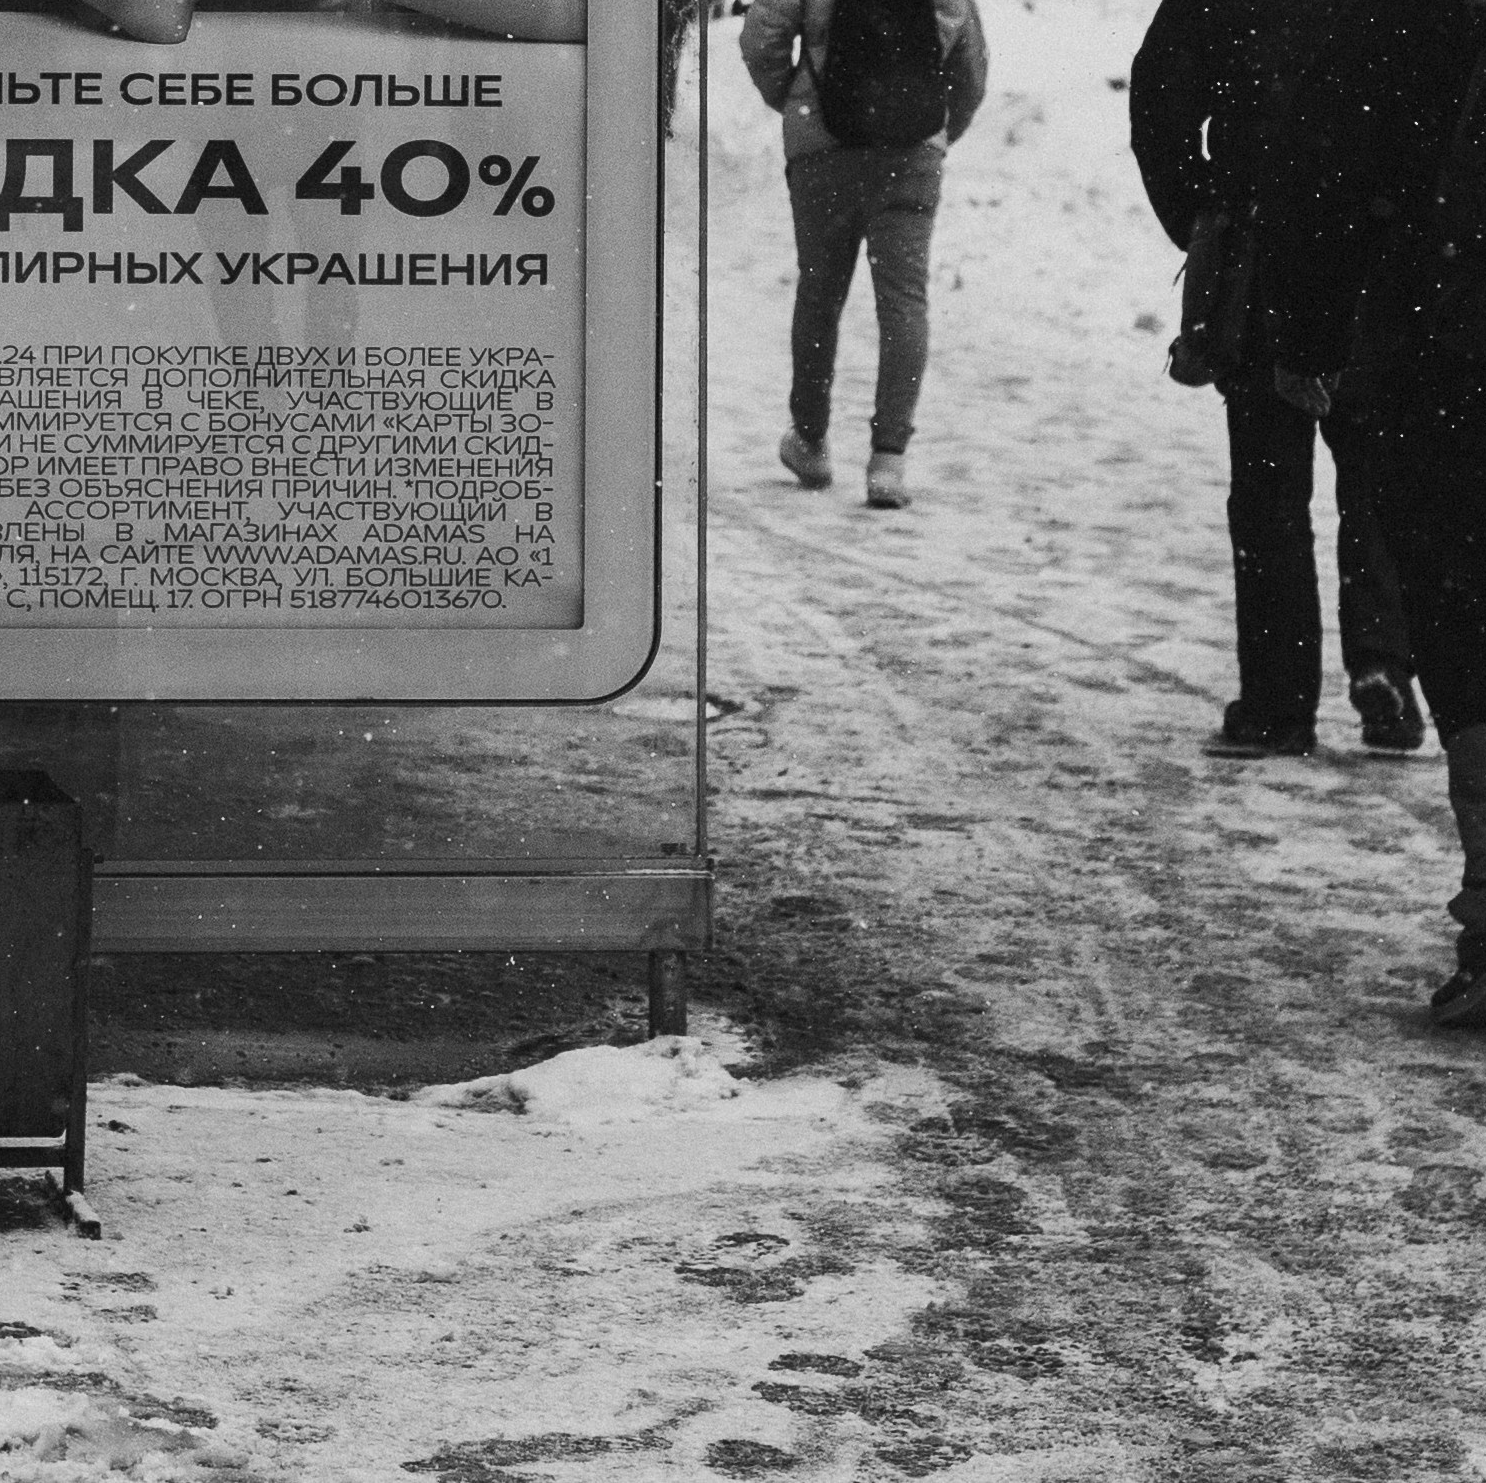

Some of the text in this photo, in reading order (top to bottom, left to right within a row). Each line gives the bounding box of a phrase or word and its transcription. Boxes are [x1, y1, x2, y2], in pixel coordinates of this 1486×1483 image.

[120, 72, 254, 107] СЕБЕ
[270, 73, 503, 108] БОЛЬШЕ
[294, 138, 556, 218] 40%
[216, 251, 550, 287] УКРАШЕНИЯ
[43, 345, 103, 365] ПРИ
[111, 345, 249, 365] ПОКУПКЕ
[254, 346, 330, 370] ДВУХ
[337, 346, 356, 366] И
[364, 346, 462, 366] БОЛЕЕ
[468, 346, 555, 366] УКРА-
[141, 368, 426, 392] ДОПОЛНИТЕЛЬНАЯ
[439, 368, 557, 393] СКИДКА
[144, 390, 164, 410] В
[186, 390, 265, 414] ЧЕКЕ,
[285, 390, 514, 415] УЧАСТВУЮЩИЕ
[535, 391, 554, 411] В
[180, 412, 201, 432] С
[208, 412, 375, 432] БОНУСАМИ
[500, 413, 554, 433] ЗО-
[19, 434, 57, 454] НЕ
[63, 434, 285, 454] СУММИРУЕТСЯ
[291, 434, 312, 454] С
[316, 435, 457, 459] ДРУГИМИ
[463, 435, 554, 460] СКИД-
[37, 456, 136, 476] ИМЕЕТ
[141, 456, 244, 476] ПРАВО
[251, 457, 366, 477] ВНЕСТИ
[374, 457, 554, 477] ИЗМЕНЕНИЯ
[58, 478, 263, 498] ОБЪЯСНЕНИЯ
[271, 479, 397, 499] ПРИЧИН.
[24, 500, 251, 525] АССОРТИМЕНТ,
[277, 496, 507, 526] УЧАСТВУЮЩИЙ
[535, 502, 554, 522] В
[115, 522, 134, 542] В
[163, 523, 338, 543] МАГАЗИНАХ
[361, 523, 486, 543] ADAMAS
[515, 524, 556, 544] НА
[50, 545, 91, 565] НА
[99, 540, 195, 565] САЙТЕ
[202, 545, 467, 565] WWW.ADAMAS.RU.
[475, 546, 519, 566] АО
[19, 567, 109, 591] 115172,
[120, 567, 139, 587] Г.
[150, 567, 283, 592] МОСКВА,
[293, 567, 334, 587] УЛ.
[346, 568, 492, 588] БОЛЬШИЕ
[503, 568, 553, 588] КА-
[6, 588, 32, 613] С,
[39, 589, 160, 613] ПОМЕЩ.
[166, 589, 194, 609] 17.
[200, 589, 282, 609] ОГРН
[289, 590, 507, 610] 5187746013670.
